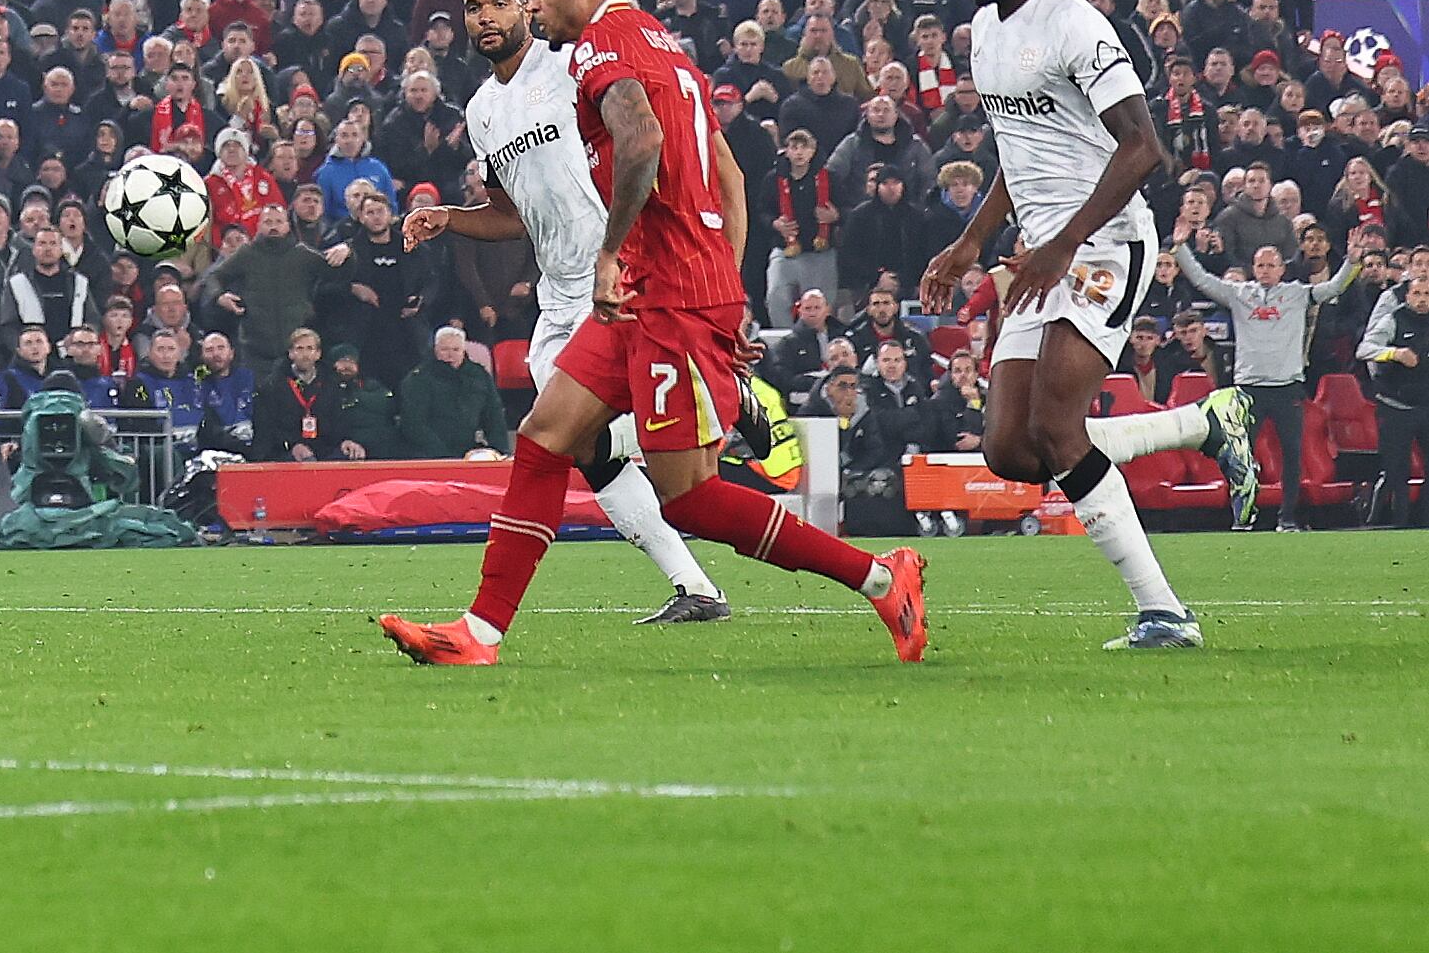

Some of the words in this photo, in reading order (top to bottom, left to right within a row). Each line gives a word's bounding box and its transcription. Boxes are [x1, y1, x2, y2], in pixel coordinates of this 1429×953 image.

[488, 122, 561, 171] armenia
[674, 65, 710, 189] 7
[1072, 264, 1115, 306] 12
[651, 363, 678, 416] 7
